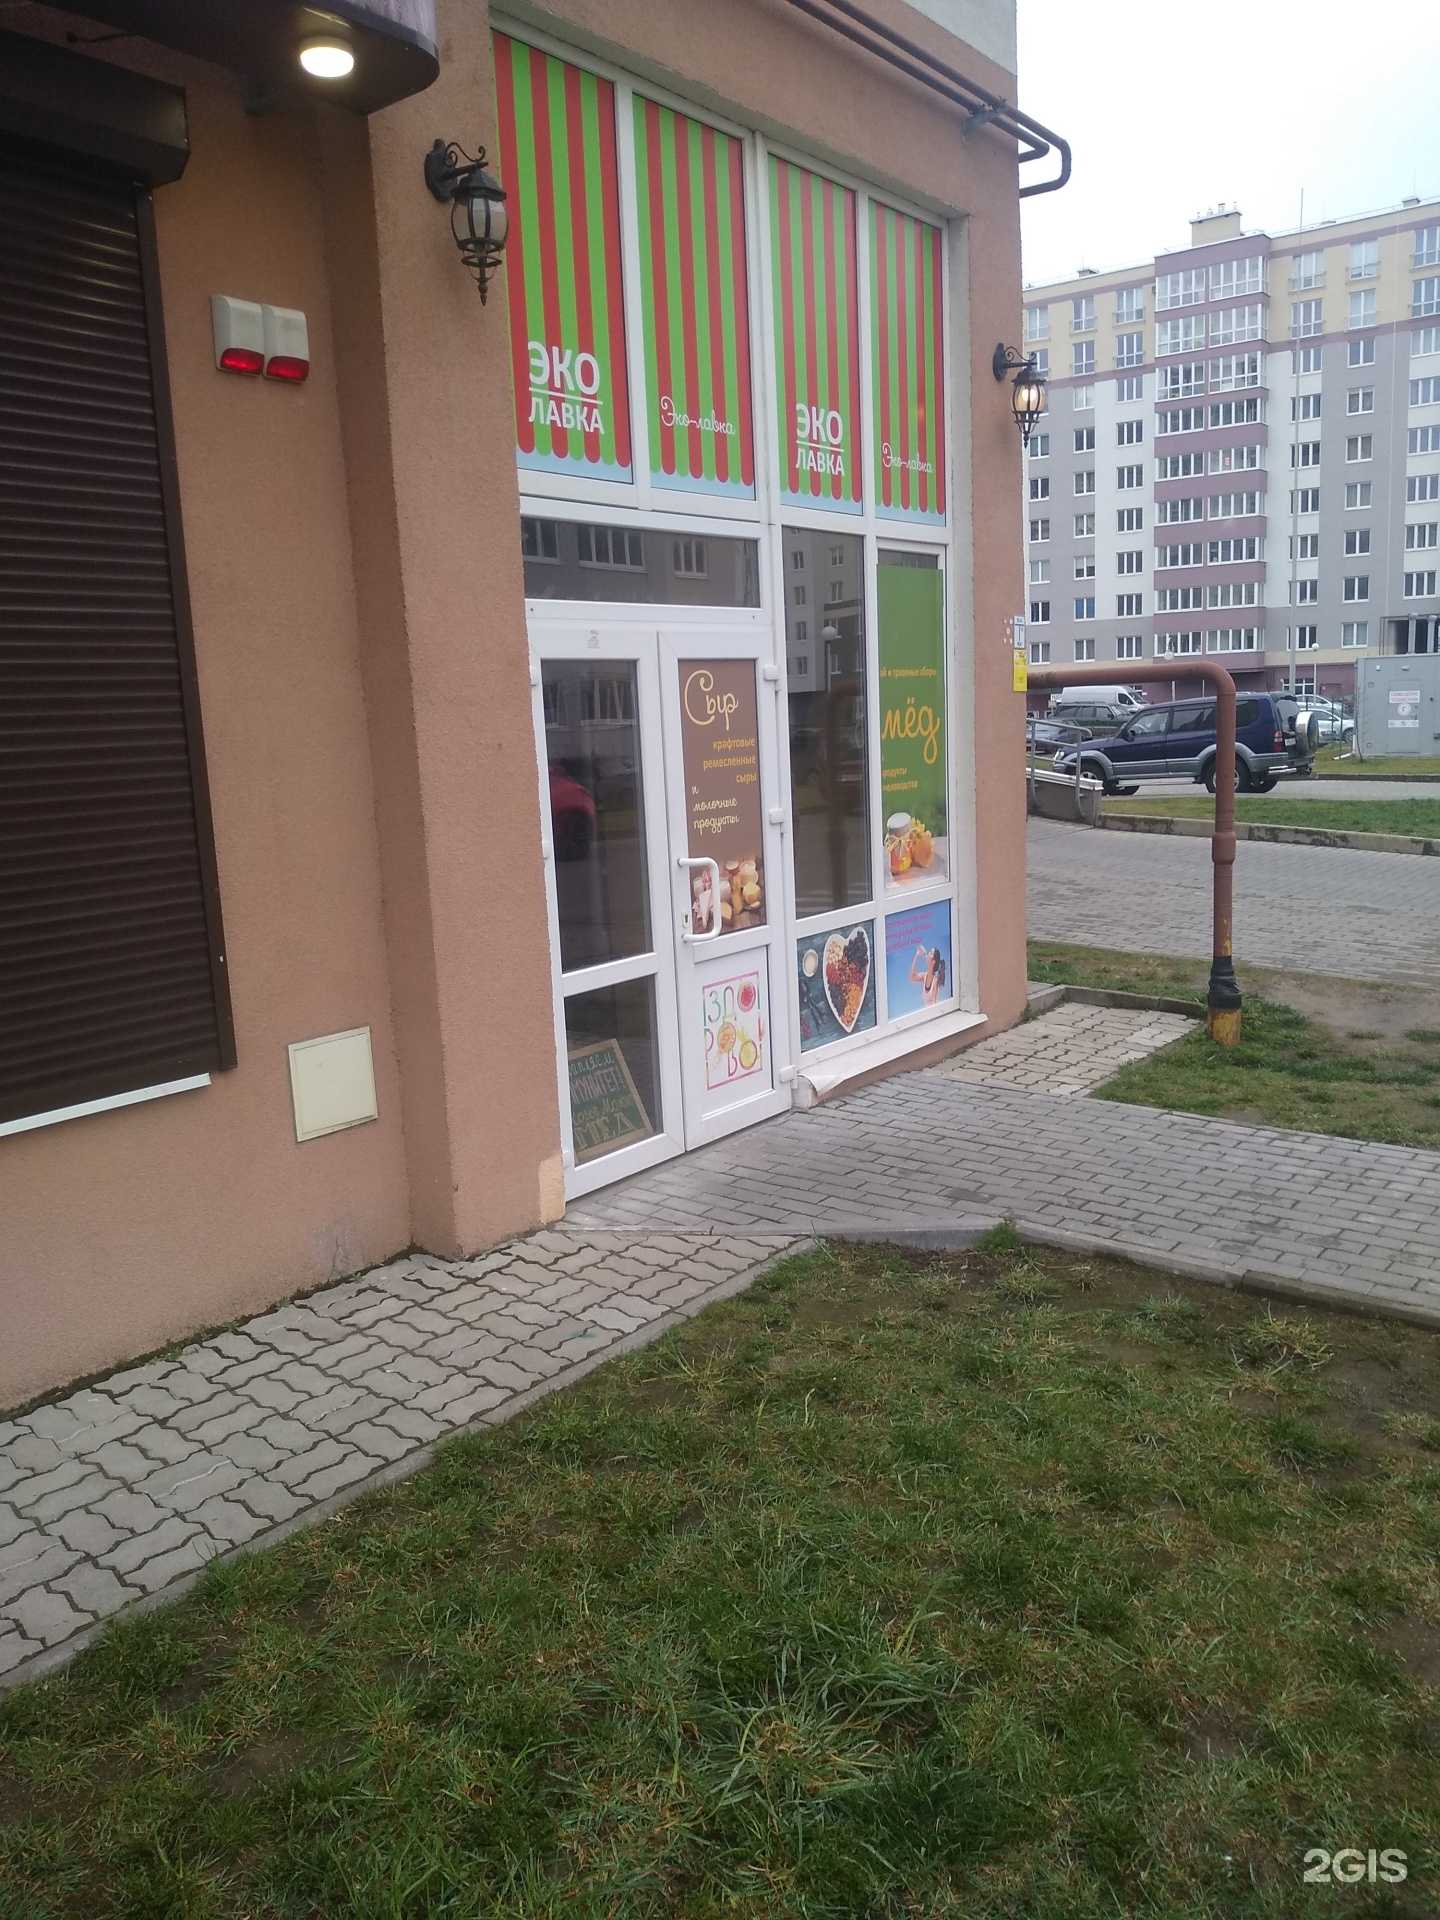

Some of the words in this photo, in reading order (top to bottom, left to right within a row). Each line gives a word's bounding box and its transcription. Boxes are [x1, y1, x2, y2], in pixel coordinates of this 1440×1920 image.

[528, 341, 600, 396] ЭКО
[528, 397, 605, 435] ЛАВКА
[660, 395, 736, 436] Эко-лавка
[795, 402, 843, 445] ЭКО
[795, 447, 845, 477] ЛАВКА
[684, 669, 739, 731] Сыр
[713, 737, 756, 752] крафтовые
[881, 697, 941, 765] мёд
[703, 755, 757, 771] ремесленные
[736, 772, 757, 785] сыры
[693, 797, 738, 812] молочные
[694, 815, 740, 836] продукты
